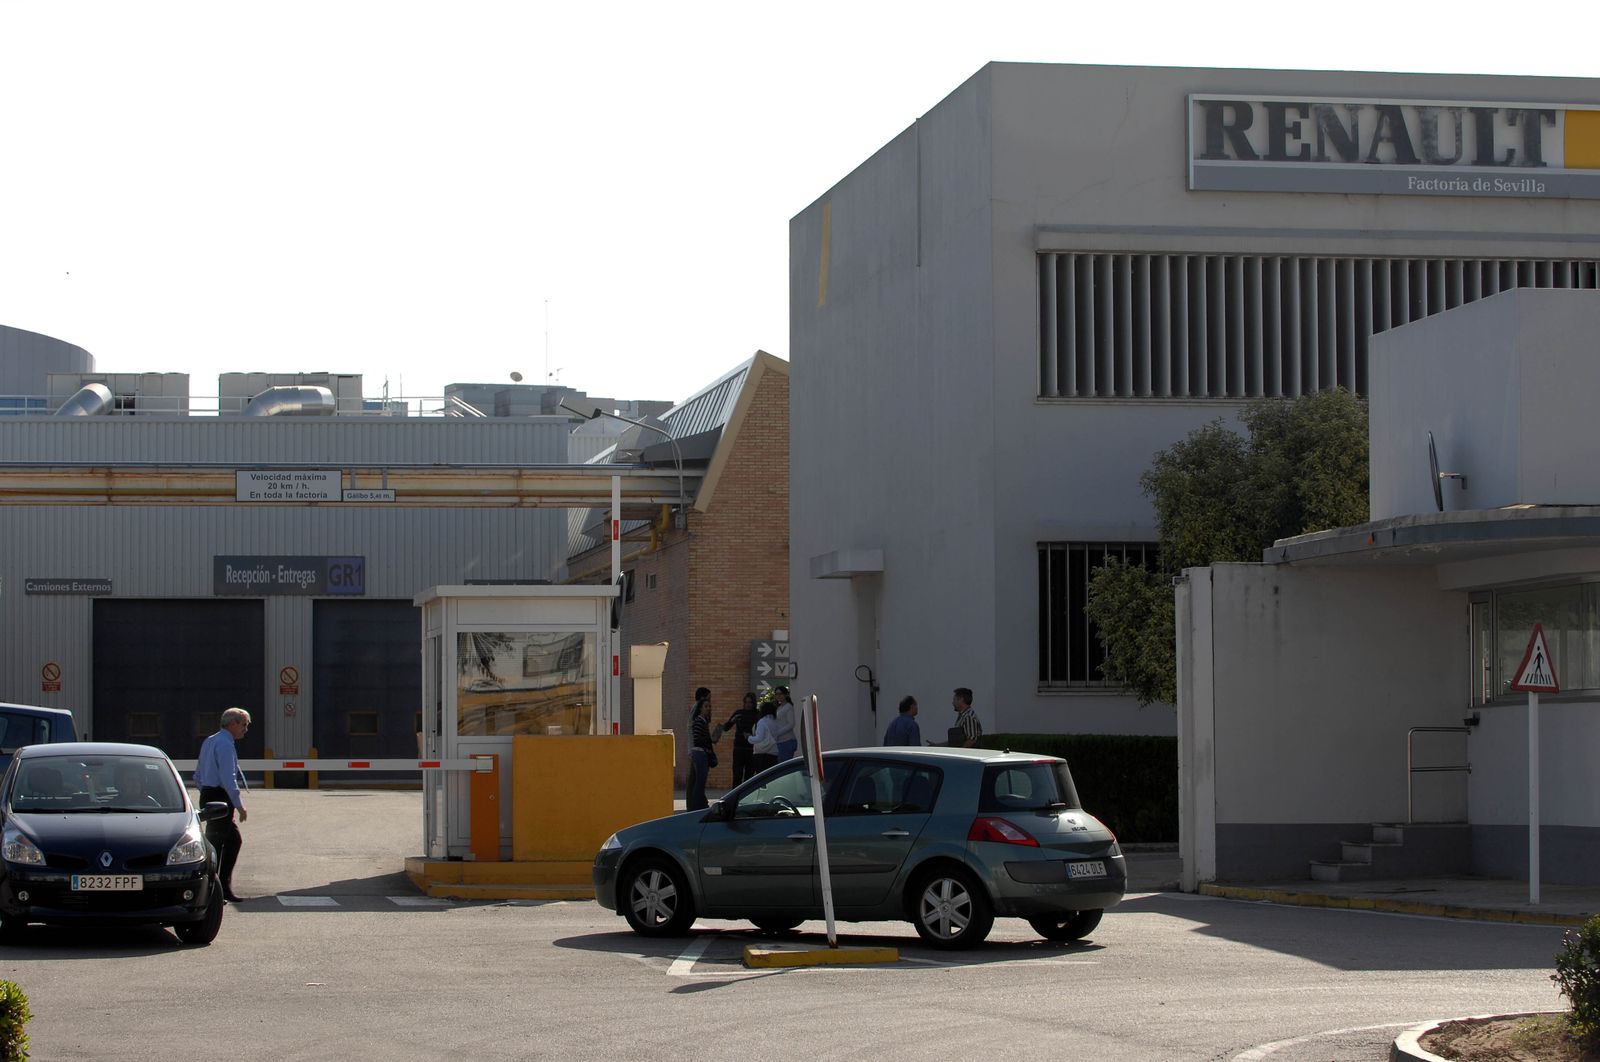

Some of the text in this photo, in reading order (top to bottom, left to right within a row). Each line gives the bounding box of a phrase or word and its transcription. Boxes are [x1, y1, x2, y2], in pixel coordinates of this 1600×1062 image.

[1199, 100, 1556, 168] RENAULT
[1407, 175, 1546, 194] Factoría de Sevilla
[250, 473, 327, 481] Velocidad máxima
[267, 482, 278, 490] 20
[280, 482, 294, 490] km
[301, 482, 310, 490] h.
[250, 491, 261, 499] En
[263, 491, 283, 499] toda
[285, 491, 293, 499] la
[225, 564, 271, 589] Recepción
[277, 565, 316, 589] Entregas
[328, 563, 362, 587] GR1
[26, 581, 112, 592] Camiones Externos
[1070, 863, 1091, 876] 6424
[80, 876, 138, 889] 8232 FPF
